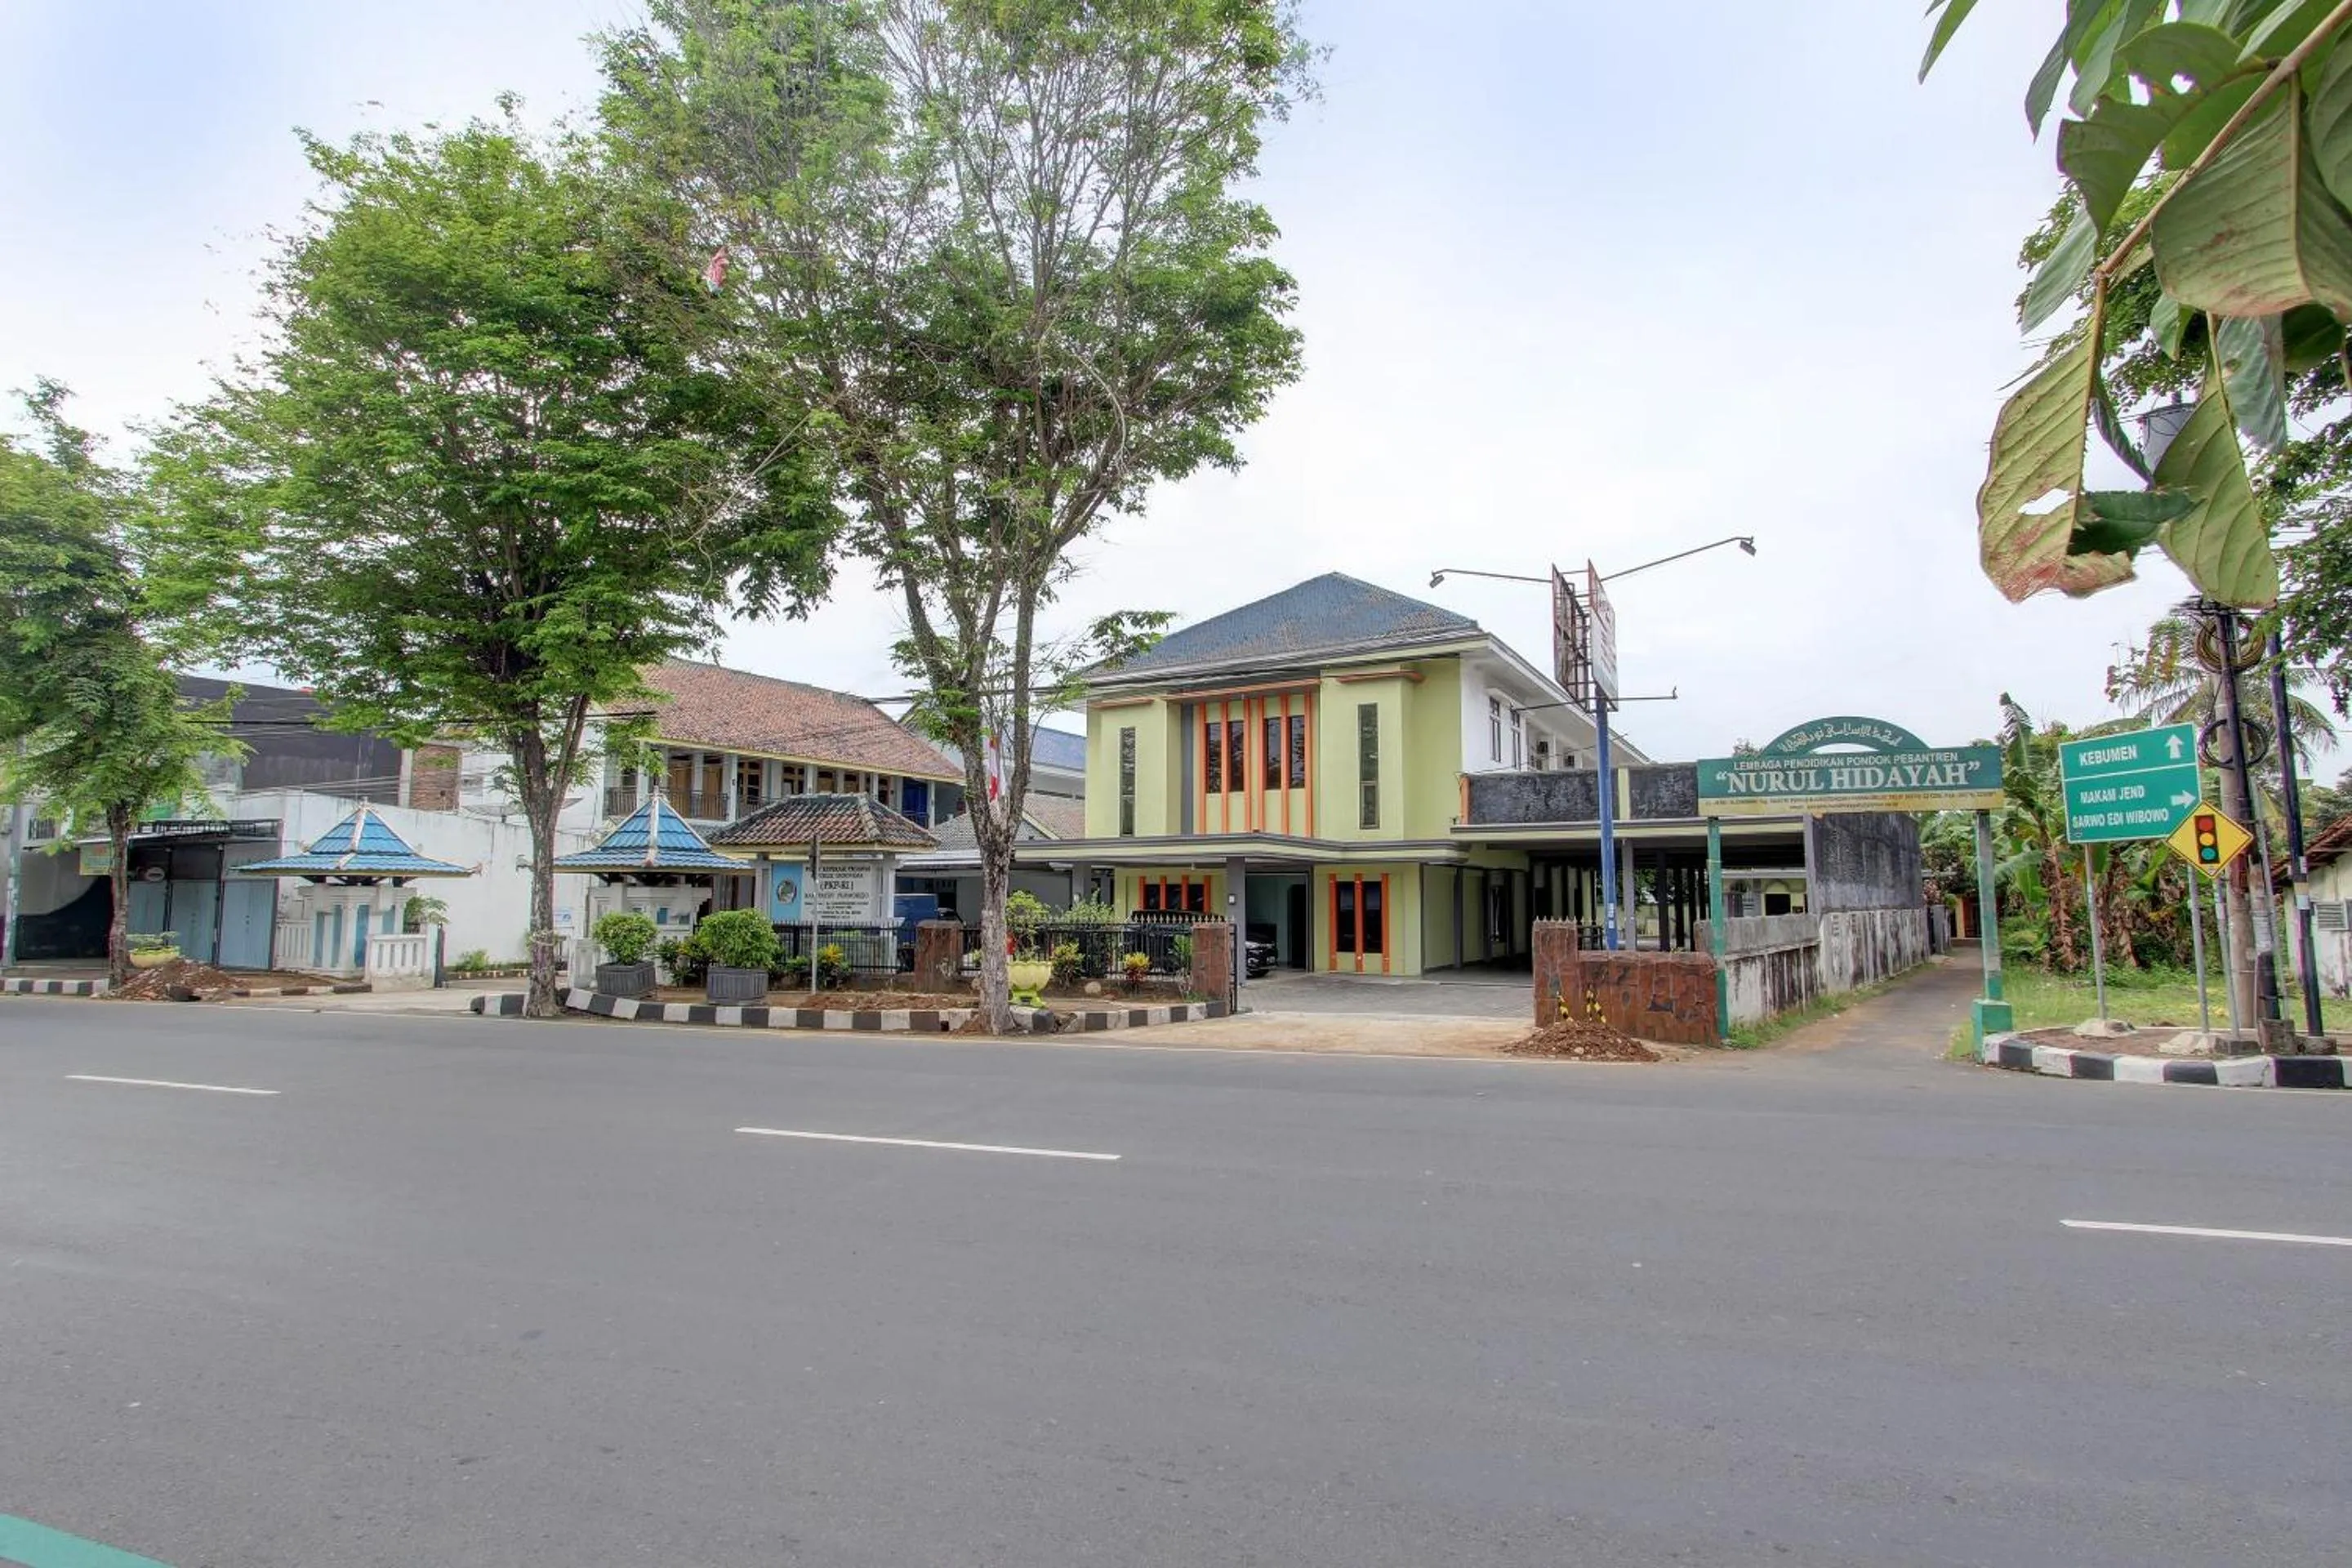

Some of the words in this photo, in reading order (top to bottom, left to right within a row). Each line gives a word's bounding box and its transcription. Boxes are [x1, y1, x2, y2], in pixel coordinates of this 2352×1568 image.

[1734, 760, 1782, 771] LEMBAGA
[1784, 757, 1844, 768] PENDIDIKAN
[1846, 755, 1891, 766] PONDOK
[1893, 752, 1958, 764] PESANTREN
[2078, 744, 2138, 766] KEBUMEN
[2080, 788, 2117, 804] MAKAM
[2118, 785, 2145, 800] JEND
[2072, 813, 2105, 828] SARWO
[2107, 812, 2123, 826] EDI
[2125, 808, 2169, 824] WIBOWO
